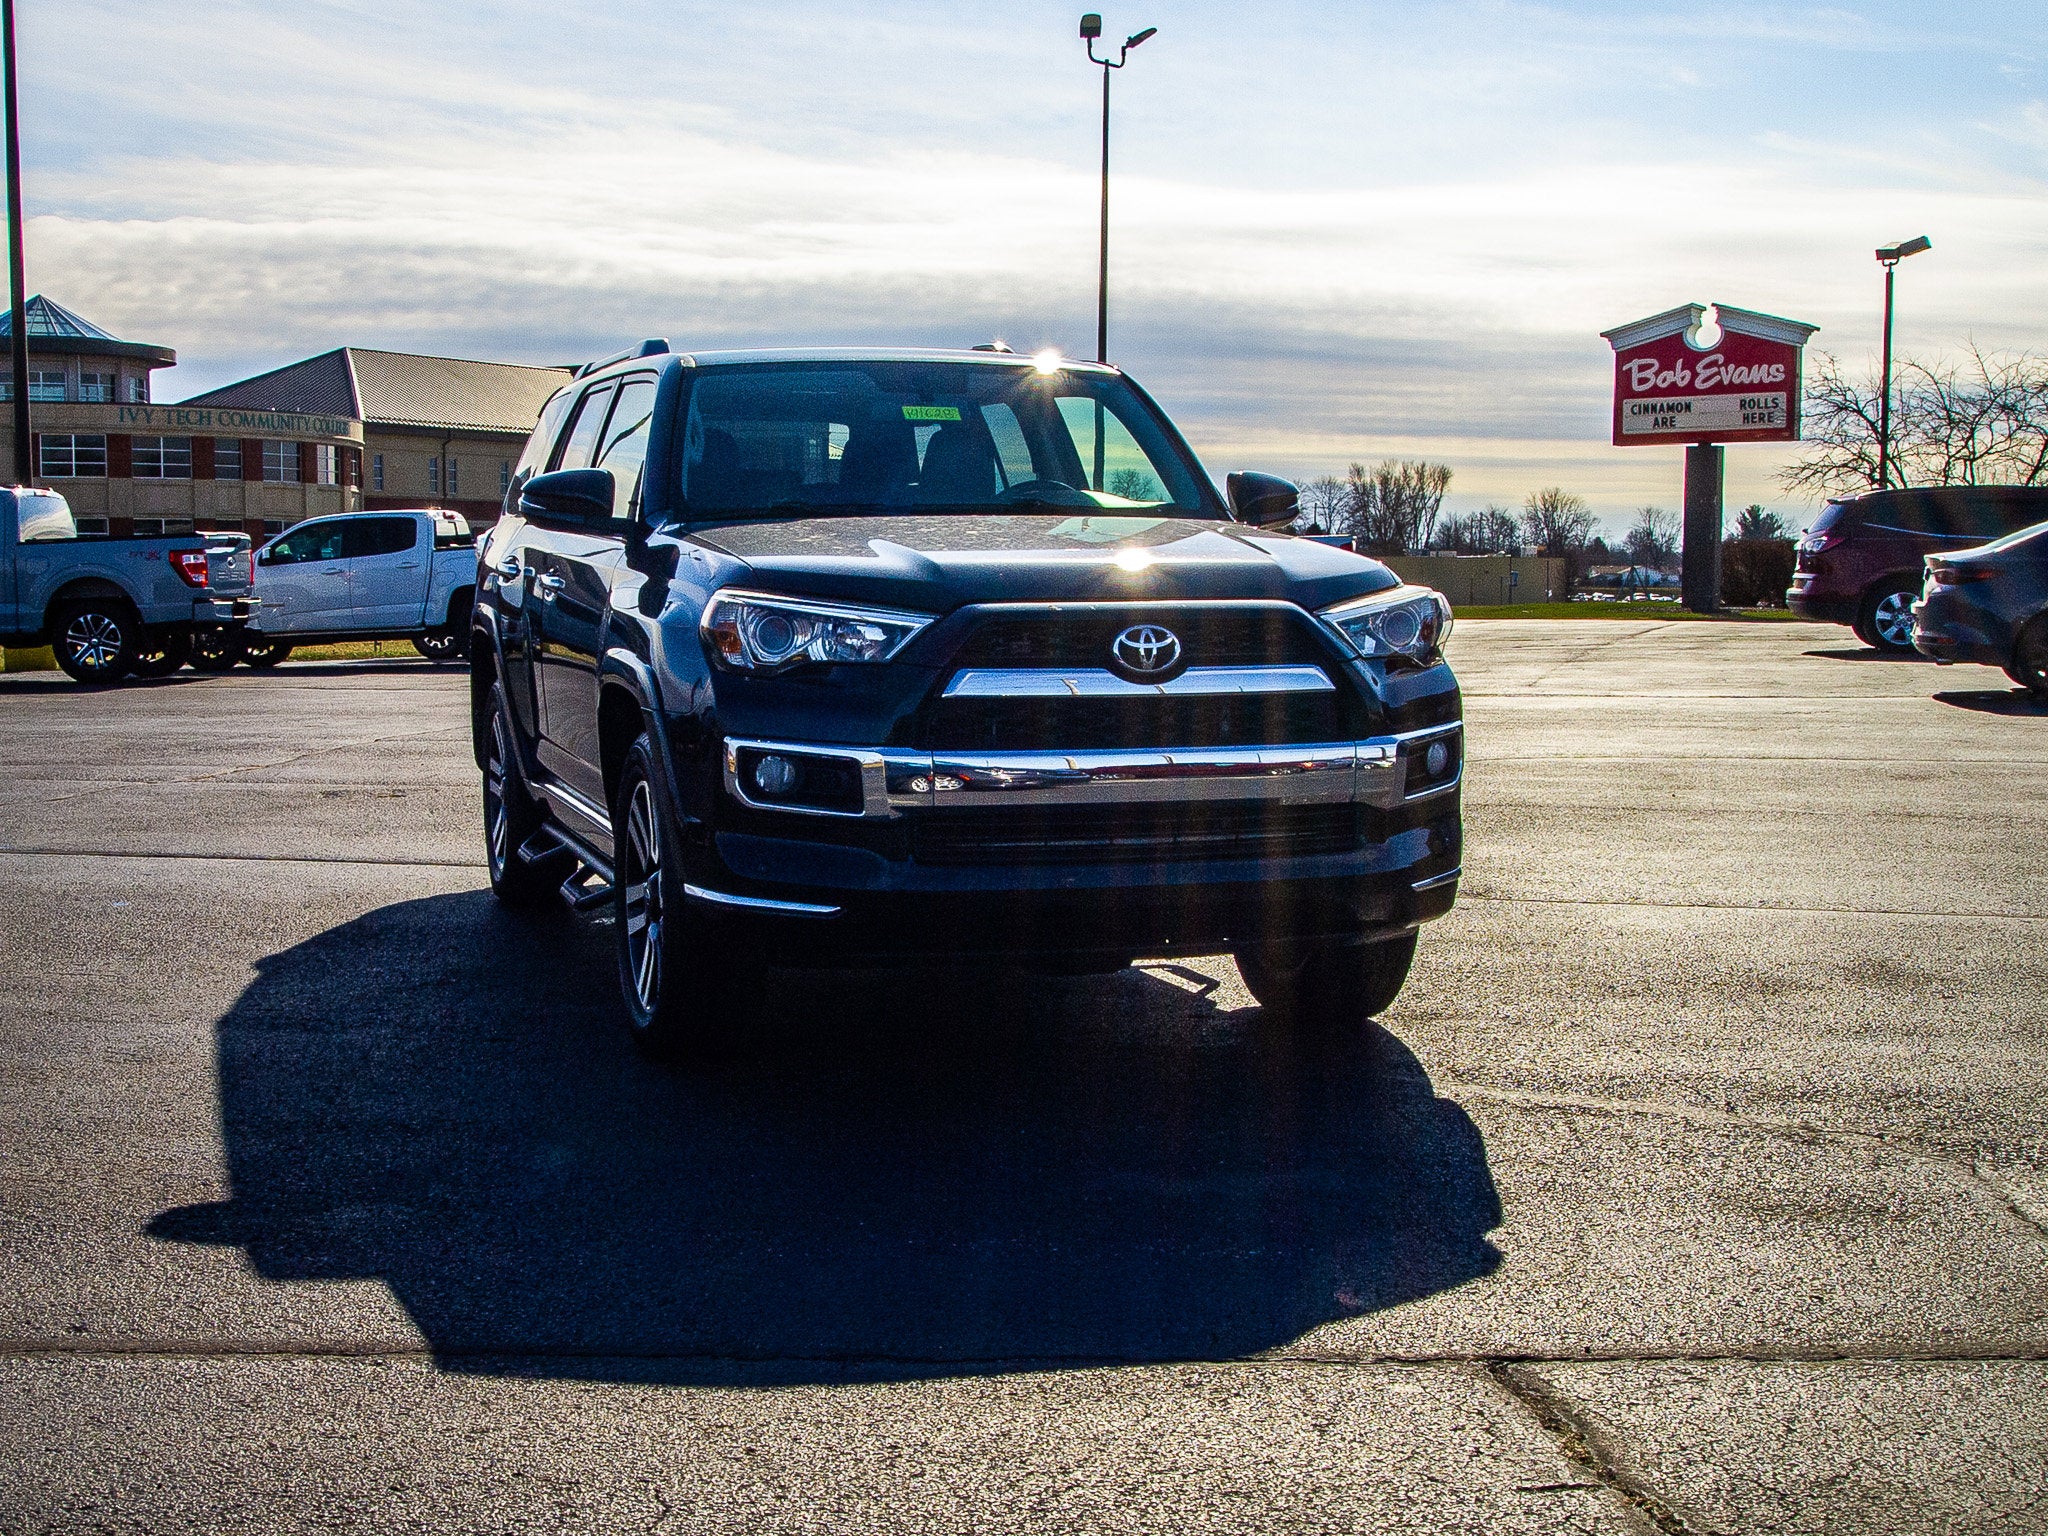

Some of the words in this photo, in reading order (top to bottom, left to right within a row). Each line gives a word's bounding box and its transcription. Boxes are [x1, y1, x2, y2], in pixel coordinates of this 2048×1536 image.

[1622, 358, 1692, 392] Bob
[1694, 353, 1786, 389] Evans
[1630, 401, 1692, 416] CINNAMON
[1739, 397, 1779, 411] ROLLS
[119, 406, 152, 423] IVY
[165, 408, 211, 426] TECH
[217, 410, 311, 431] COMMUNITY
[1652, 415, 1677, 428] ARE
[1742, 411, 1775, 424] HERE
